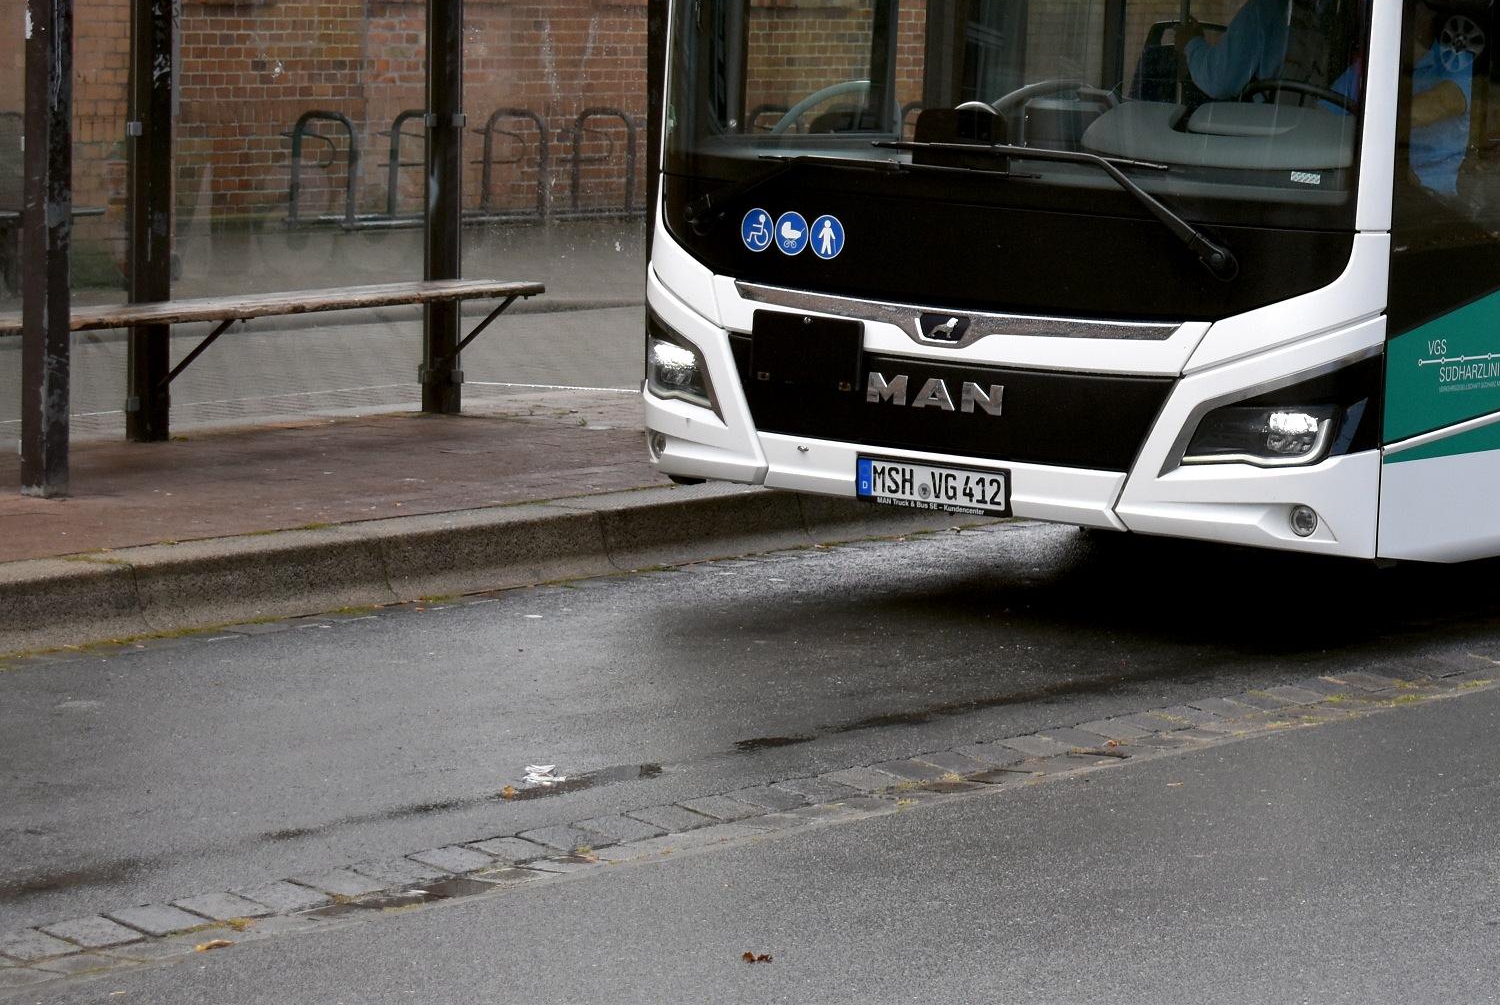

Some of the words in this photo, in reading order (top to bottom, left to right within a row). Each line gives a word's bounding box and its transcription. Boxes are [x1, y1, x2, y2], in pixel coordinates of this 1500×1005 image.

[1428, 338, 1447, 355] VGS
[866, 371, 1004, 416] MAN
[872, 464, 914, 496] MSH
[930, 471, 957, 500] VG
[962, 475, 1002, 506] 412
[877, 496, 892, 505] MAN
[893, 497, 910, 507] Truck
[916, 500, 928, 509] Bus
[929, 502, 938, 510] SE
[943, 504, 985, 515] Kundencenter
